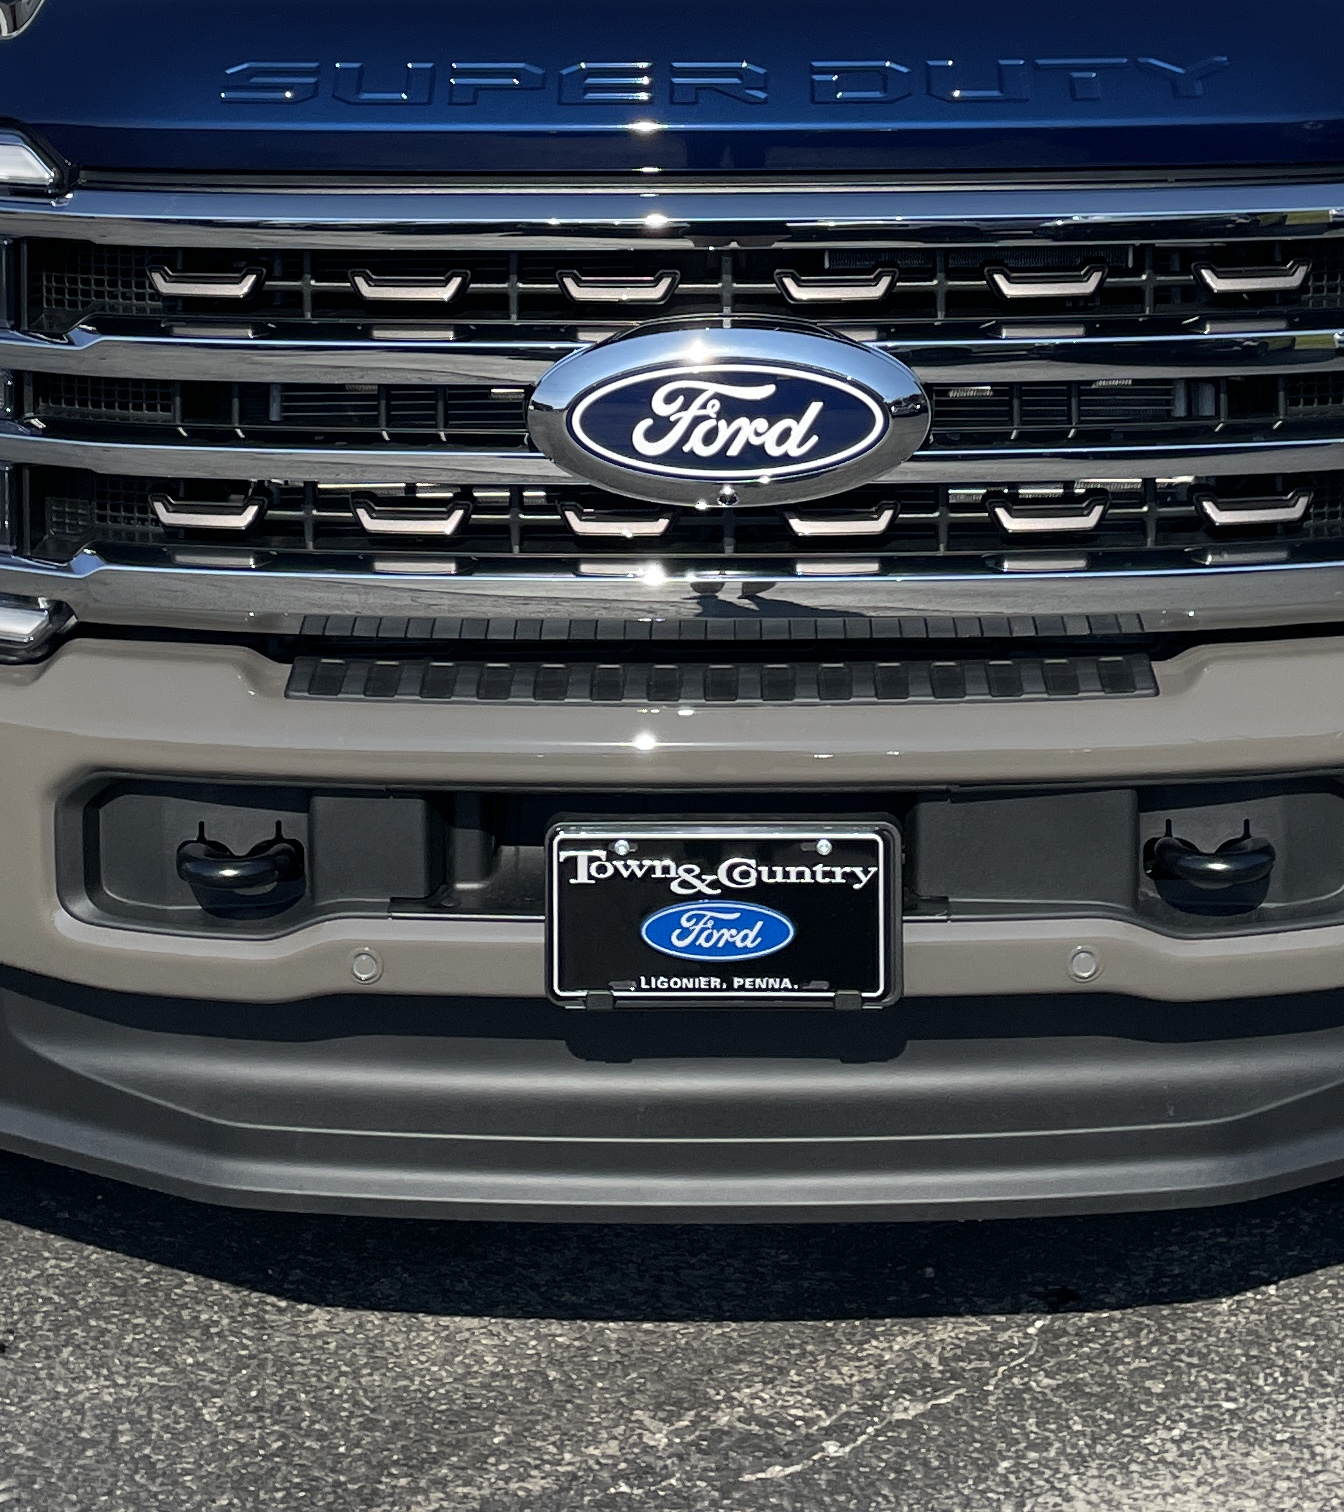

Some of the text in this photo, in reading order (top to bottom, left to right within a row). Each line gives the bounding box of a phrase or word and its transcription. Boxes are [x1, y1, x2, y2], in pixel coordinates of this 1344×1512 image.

[219, 56, 1230, 106] SUPER DUTY
[631, 379, 824, 457] Ford
[670, 910, 763, 949] Ford
[640, 975, 799, 990] LIGONIER, PENNA.
